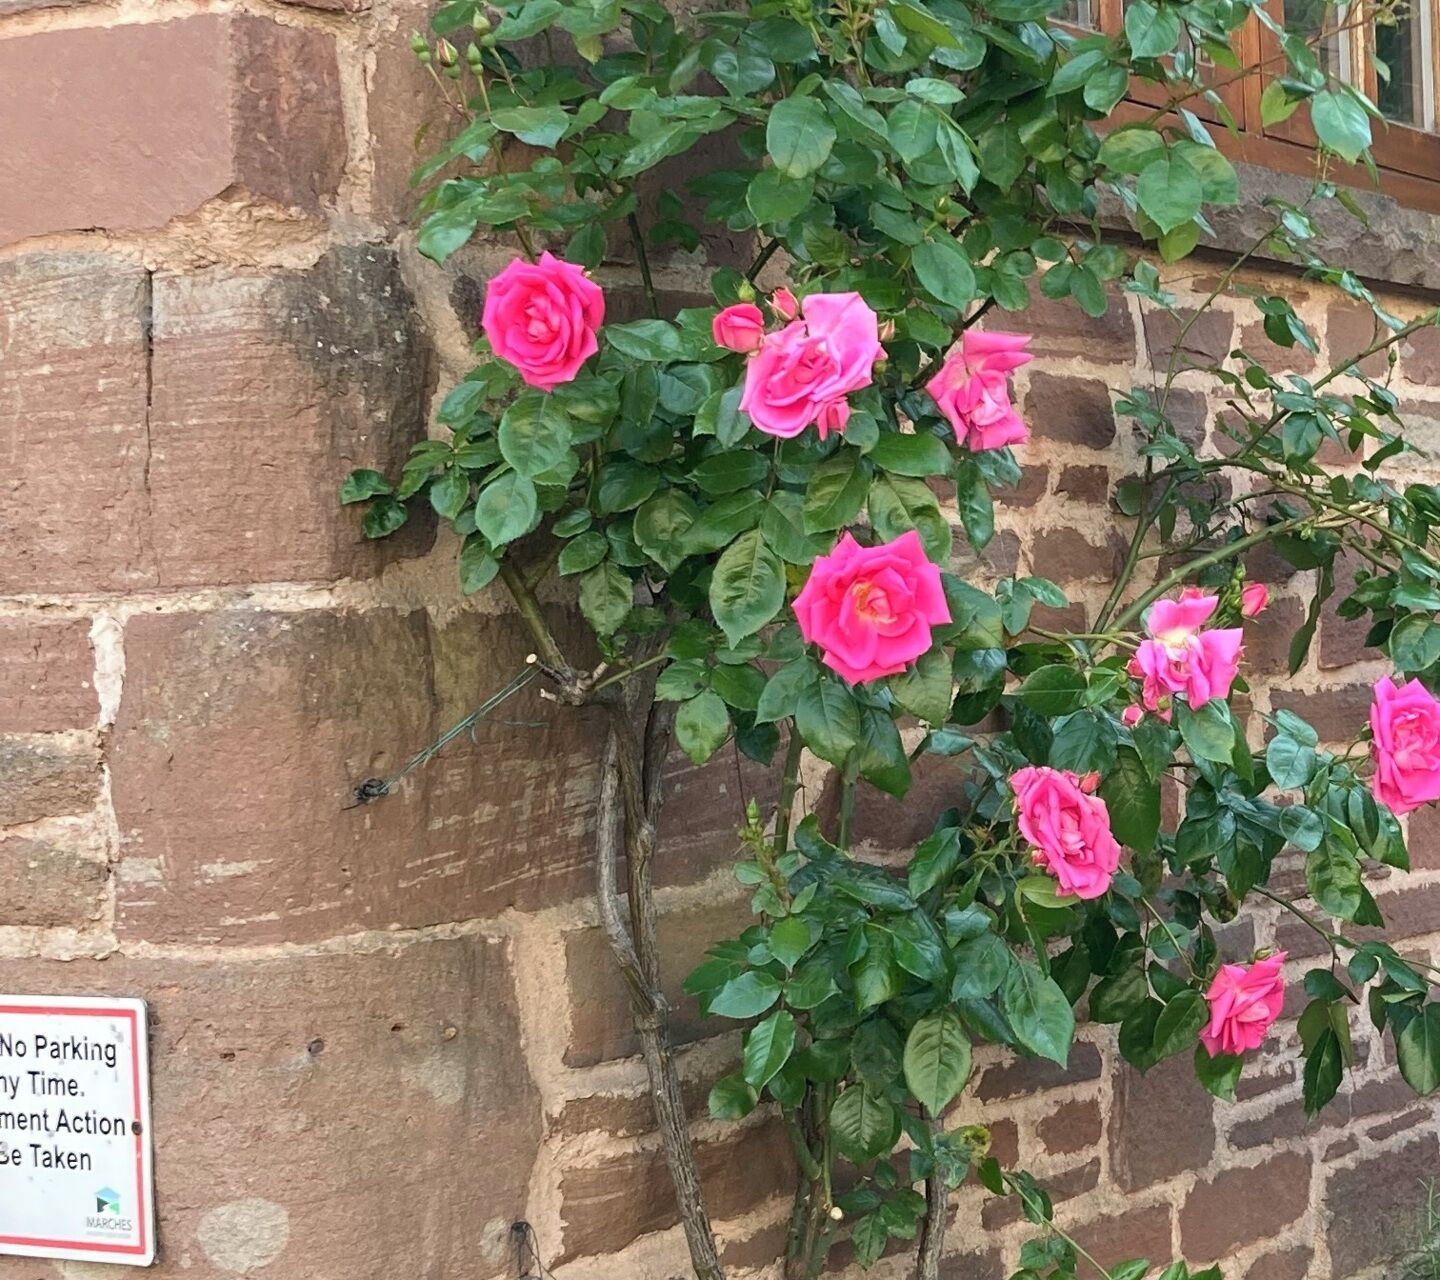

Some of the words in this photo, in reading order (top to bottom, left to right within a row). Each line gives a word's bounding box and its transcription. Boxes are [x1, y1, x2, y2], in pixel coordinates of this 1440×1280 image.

[0, 1033, 26, 1058] No
[35, 1035, 117, 1068] Parking
[28, 1071, 85, 1097] Time.
[0, 1109, 50, 1132] ment
[56, 1108, 126, 1136] Action
[29, 1143, 92, 1171] Taken
[86, 1216, 132, 1232] MARCHES
